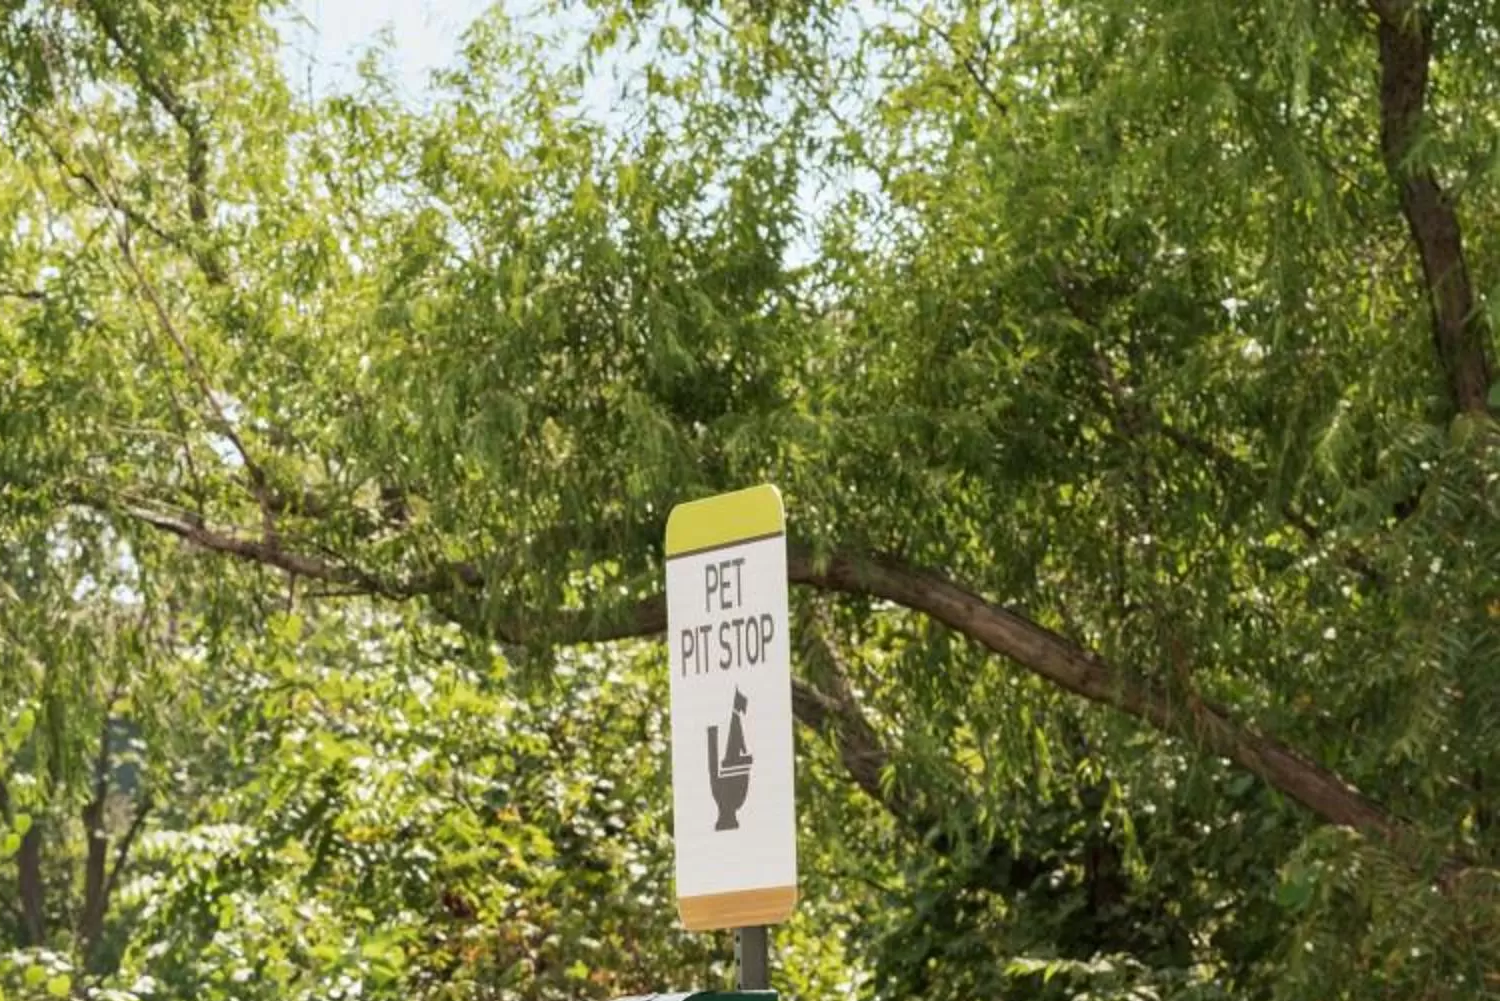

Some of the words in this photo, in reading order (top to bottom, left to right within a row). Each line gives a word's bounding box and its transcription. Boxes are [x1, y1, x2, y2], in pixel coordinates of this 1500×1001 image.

[705, 558, 745, 613] PET
[681, 624, 712, 677] PIT
[719, 613, 774, 670] STOP
